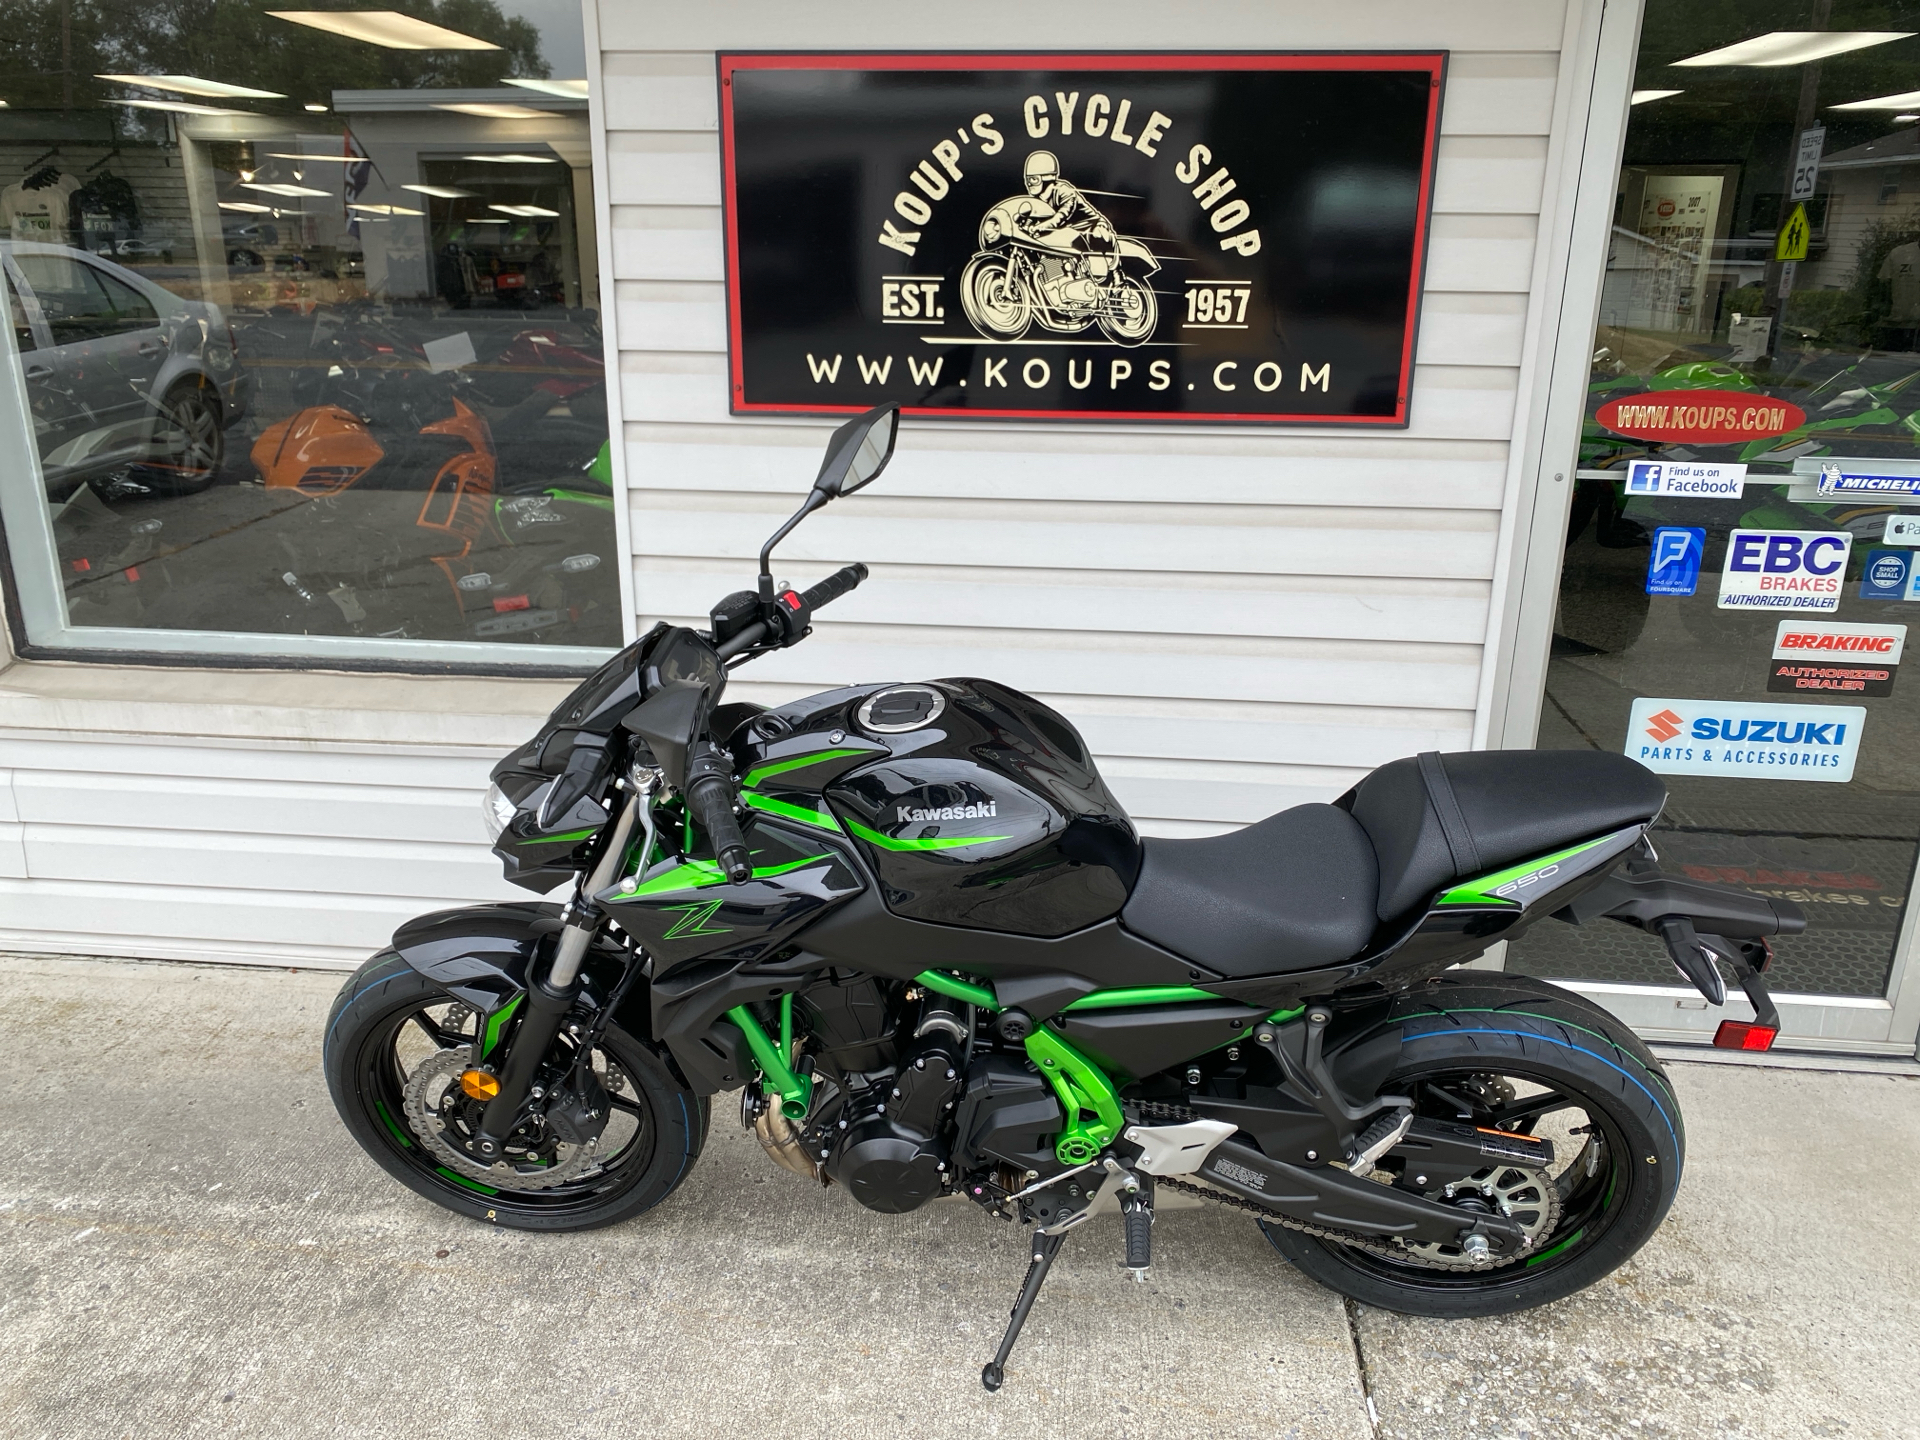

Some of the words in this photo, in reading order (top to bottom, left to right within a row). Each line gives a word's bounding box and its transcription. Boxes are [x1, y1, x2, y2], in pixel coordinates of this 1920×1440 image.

[878, 113, 1005, 257] KOUP'S
[1023, 91, 1173, 158] CYCLE
[1175, 144, 1262, 257] SHOP
[882, 283, 945, 318] EST.
[1185, 288, 1249, 324] 1957
[806, 352, 1332, 393] WWW.KOUPS.COM
[1617, 405, 1787, 431] WWW.KOUPS.COM
[1668, 467, 1690, 476] Find
[1693, 468, 1705, 477] us
[1707, 469, 1720, 477] on
[1667, 478, 1738, 493] Facebook
[1841, 478, 1920, 490] MICHELI
[1729, 534, 1846, 576] EBC
[1760, 577, 1838, 593] BRAKES
[1724, 595, 1792, 607] AUTHORIZED
[1793, 596, 1837, 609] DEALER
[1780, 634, 1897, 652] BRAKING
[1776, 667, 1889, 680] AUTHORIZED
[1796, 678, 1866, 691] DEALER
[1691, 717, 1847, 746] SUZUKI
[1641, 746, 1693, 761] PARTS
[1703, 749, 1713, 762] &
[1723, 750, 1840, 767] ACCESSORIES
[896, 801, 997, 822] Kawasaki
[1496, 864, 1559, 896] 650
